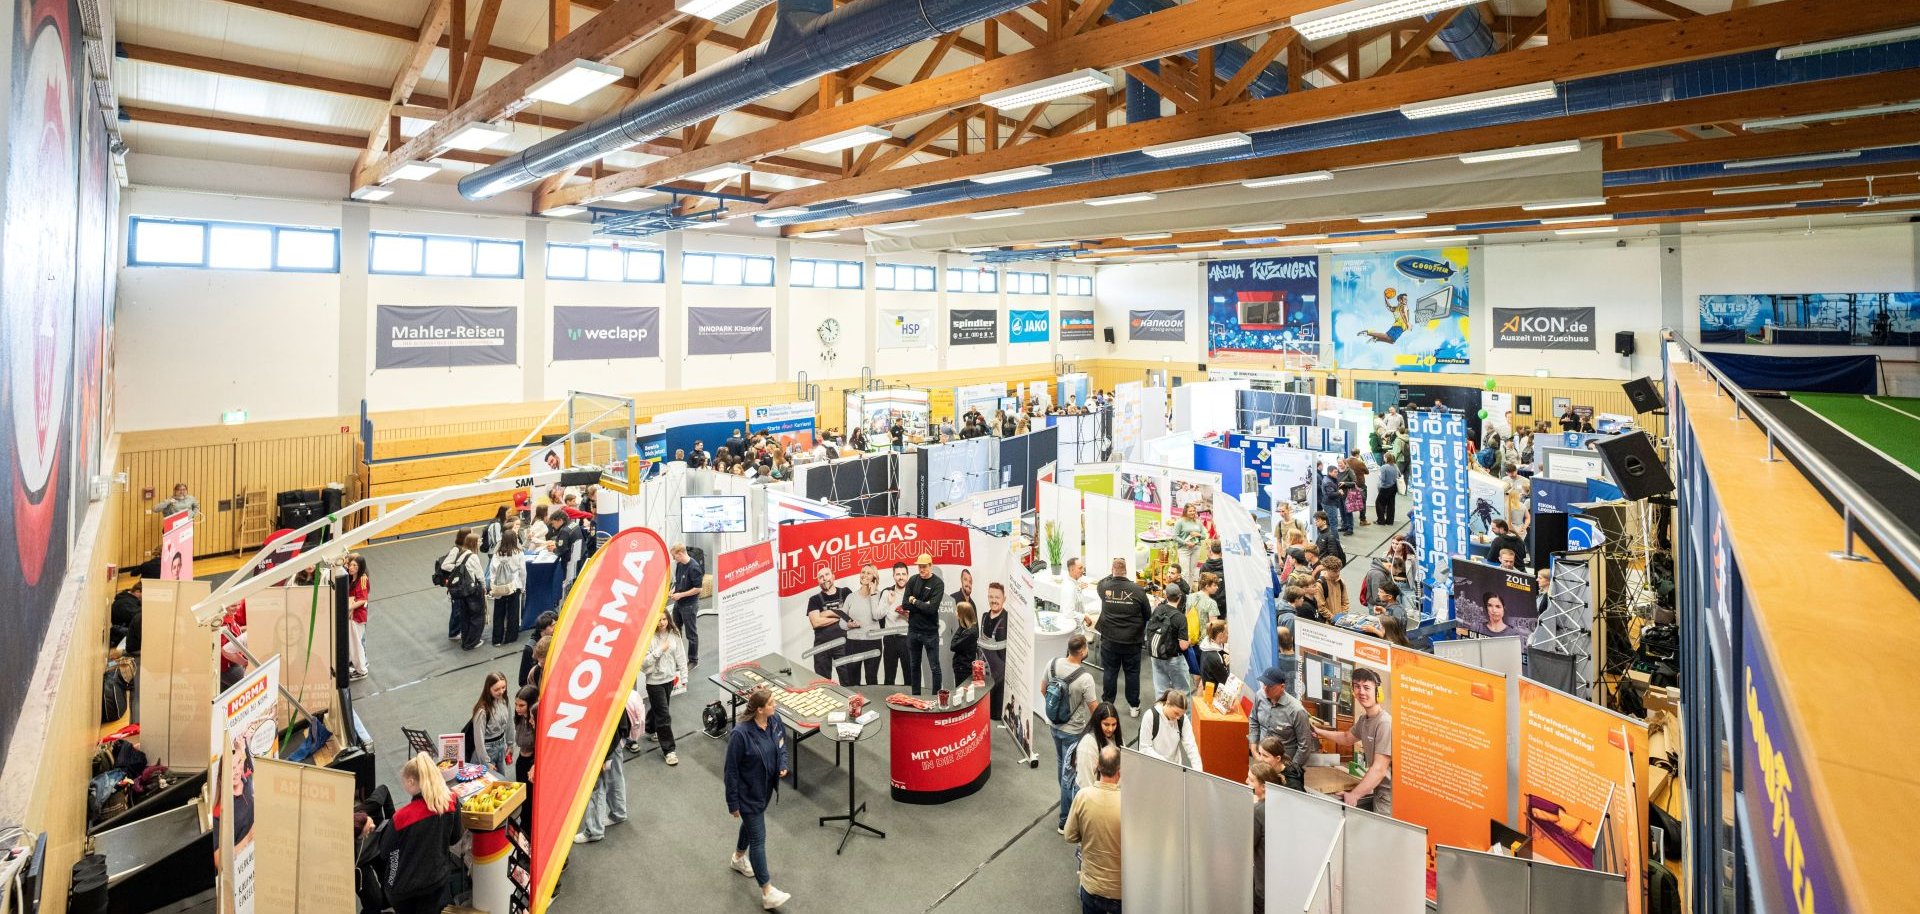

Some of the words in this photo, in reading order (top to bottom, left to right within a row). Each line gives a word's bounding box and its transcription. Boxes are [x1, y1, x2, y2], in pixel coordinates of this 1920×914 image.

[1209, 263, 1244, 281] ARENA
[1250, 260, 1317, 280] KITZINGEN
[1412, 261, 1449, 274] GOODYEAR
[392, 325, 505, 339] Mahler-Reisen
[734, 324, 763, 332] Kitzingen
[902, 323, 920, 335] HSP
[953, 319, 994, 328] spindler
[1024, 319, 1047, 332] JAKO
[1500, 314, 1588, 332] AKON.de
[585, 326, 648, 342] weclapp
[1500, 334, 1530, 342] Auszeit
[515, 477, 534, 488] SAM
[778, 548, 802, 570] IT
[808, 523, 918, 560] VOLLGAS
[724, 571, 736, 580] MIT
[736, 560, 759, 574] VOLLGAS
[781, 565, 806, 589] IN
[812, 551, 851, 580] DIE
[857, 539, 965, 566] ZUKUNFT!
[1506, 574, 1531, 587] ZOLL
[546, 551, 655, 741] NORMA
[1401, 674, 1452, 694] Schreinerlehre
[231, 681, 265, 713] NORMA
[1408, 698, 1435, 711] Lehrjahr
[934, 708, 977, 726] spindler
[1528, 710, 1586, 739] Schreinerlehre
[911, 750, 931, 761] MIT
[932, 730, 977, 757] VOLLGAS
[1428, 740, 1456, 753] Lehrjahr
[1543, 723, 1554, 733] ist
[1555, 729, 1572, 742] dein
[1573, 737, 1595, 752] Ding!
[921, 761, 935, 771] IN
[935, 753, 954, 768] DIE
